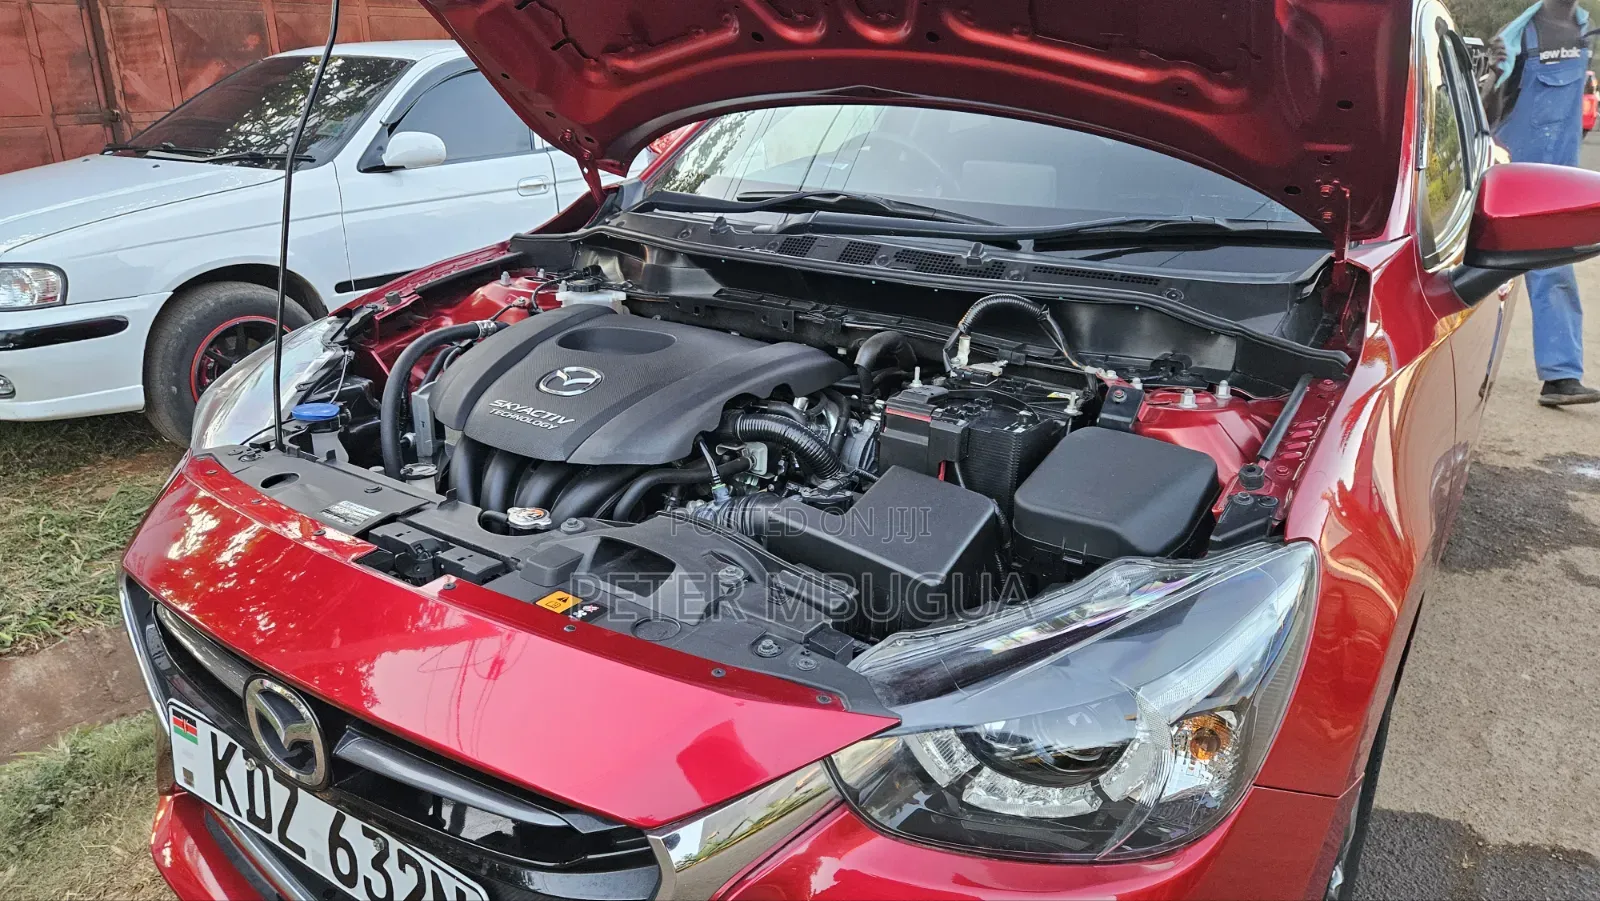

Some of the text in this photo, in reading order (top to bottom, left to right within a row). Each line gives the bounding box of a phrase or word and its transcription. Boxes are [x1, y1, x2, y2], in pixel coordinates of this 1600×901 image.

[489, 399, 576, 424] SKYACTIV
[489, 408, 558, 430] TECHNOLOGY
[211, 731, 307, 860] KDZ
